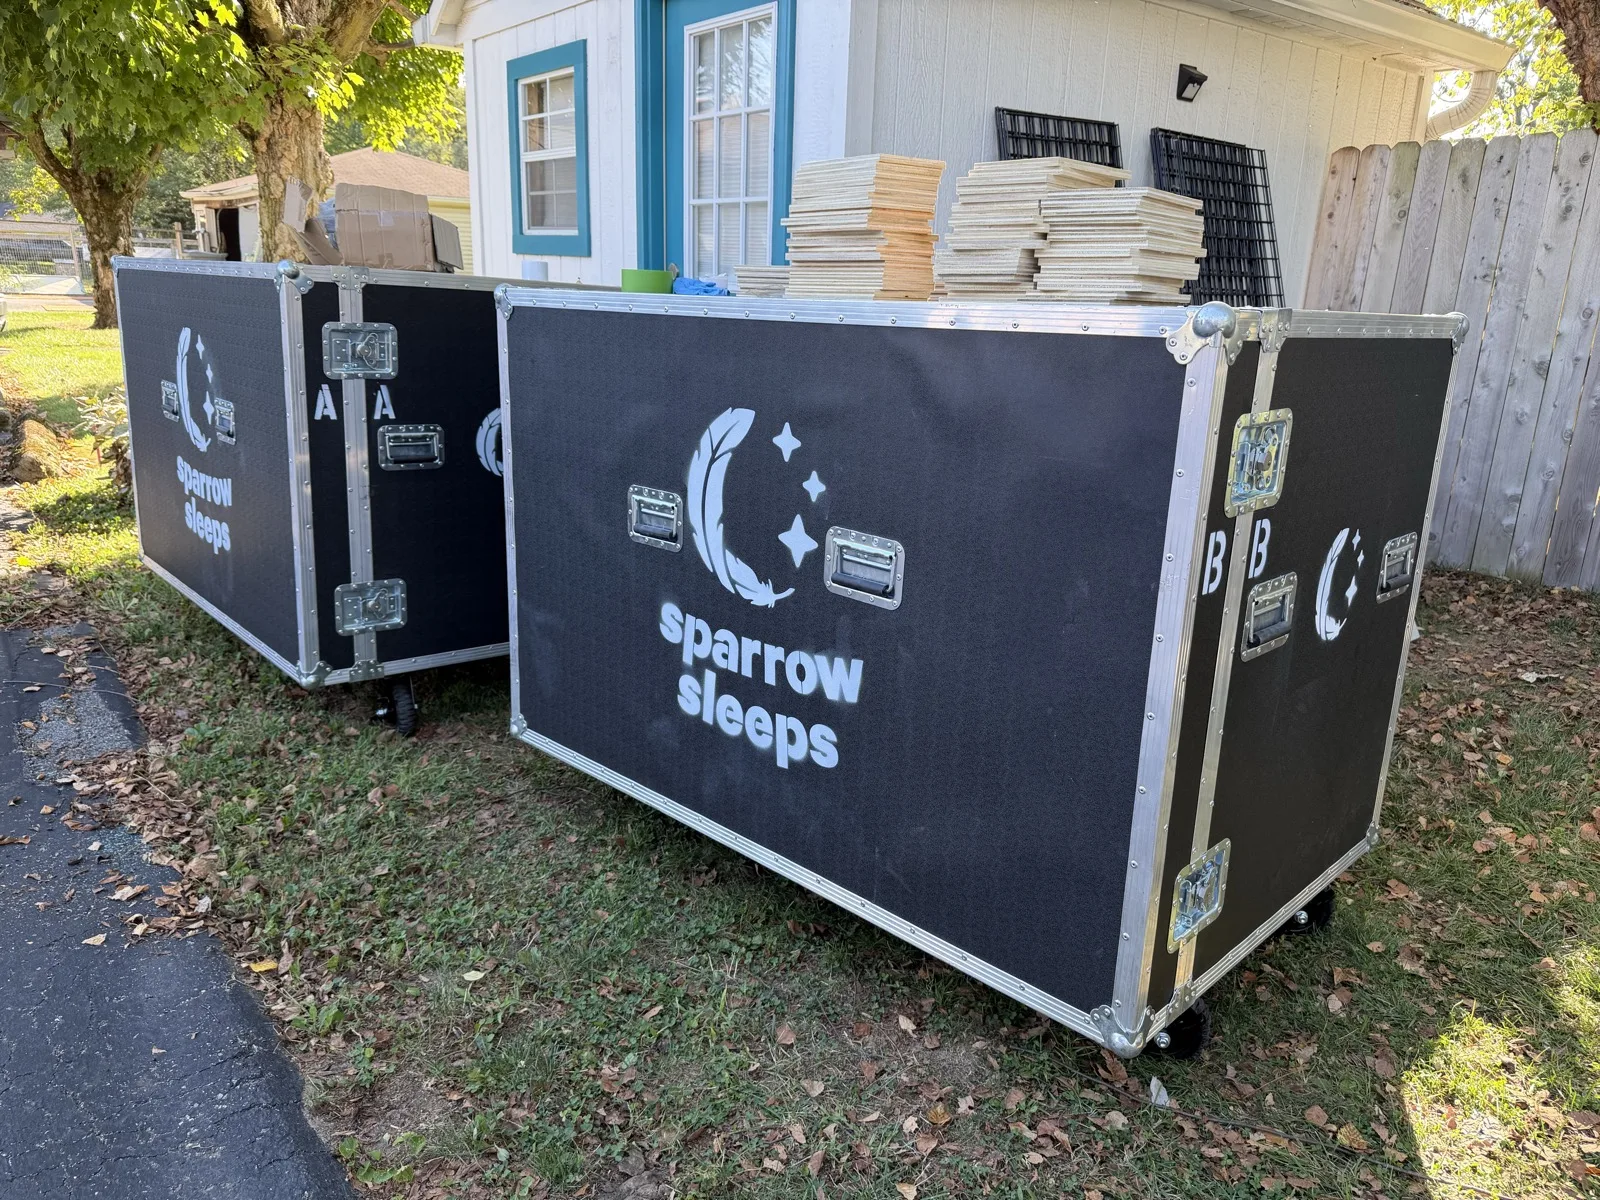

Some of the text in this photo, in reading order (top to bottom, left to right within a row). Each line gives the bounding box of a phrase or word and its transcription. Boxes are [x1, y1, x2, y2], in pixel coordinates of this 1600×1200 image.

[314, 384, 338, 421] A
[373, 384, 397, 420] A
[176, 455, 232, 507] sparrow
[184, 499, 231, 555] sleeps
[1247, 518, 1272, 579] B
[1202, 530, 1227, 596] B
[659, 602, 864, 704] sparrow
[677, 668, 839, 770] sleeps
